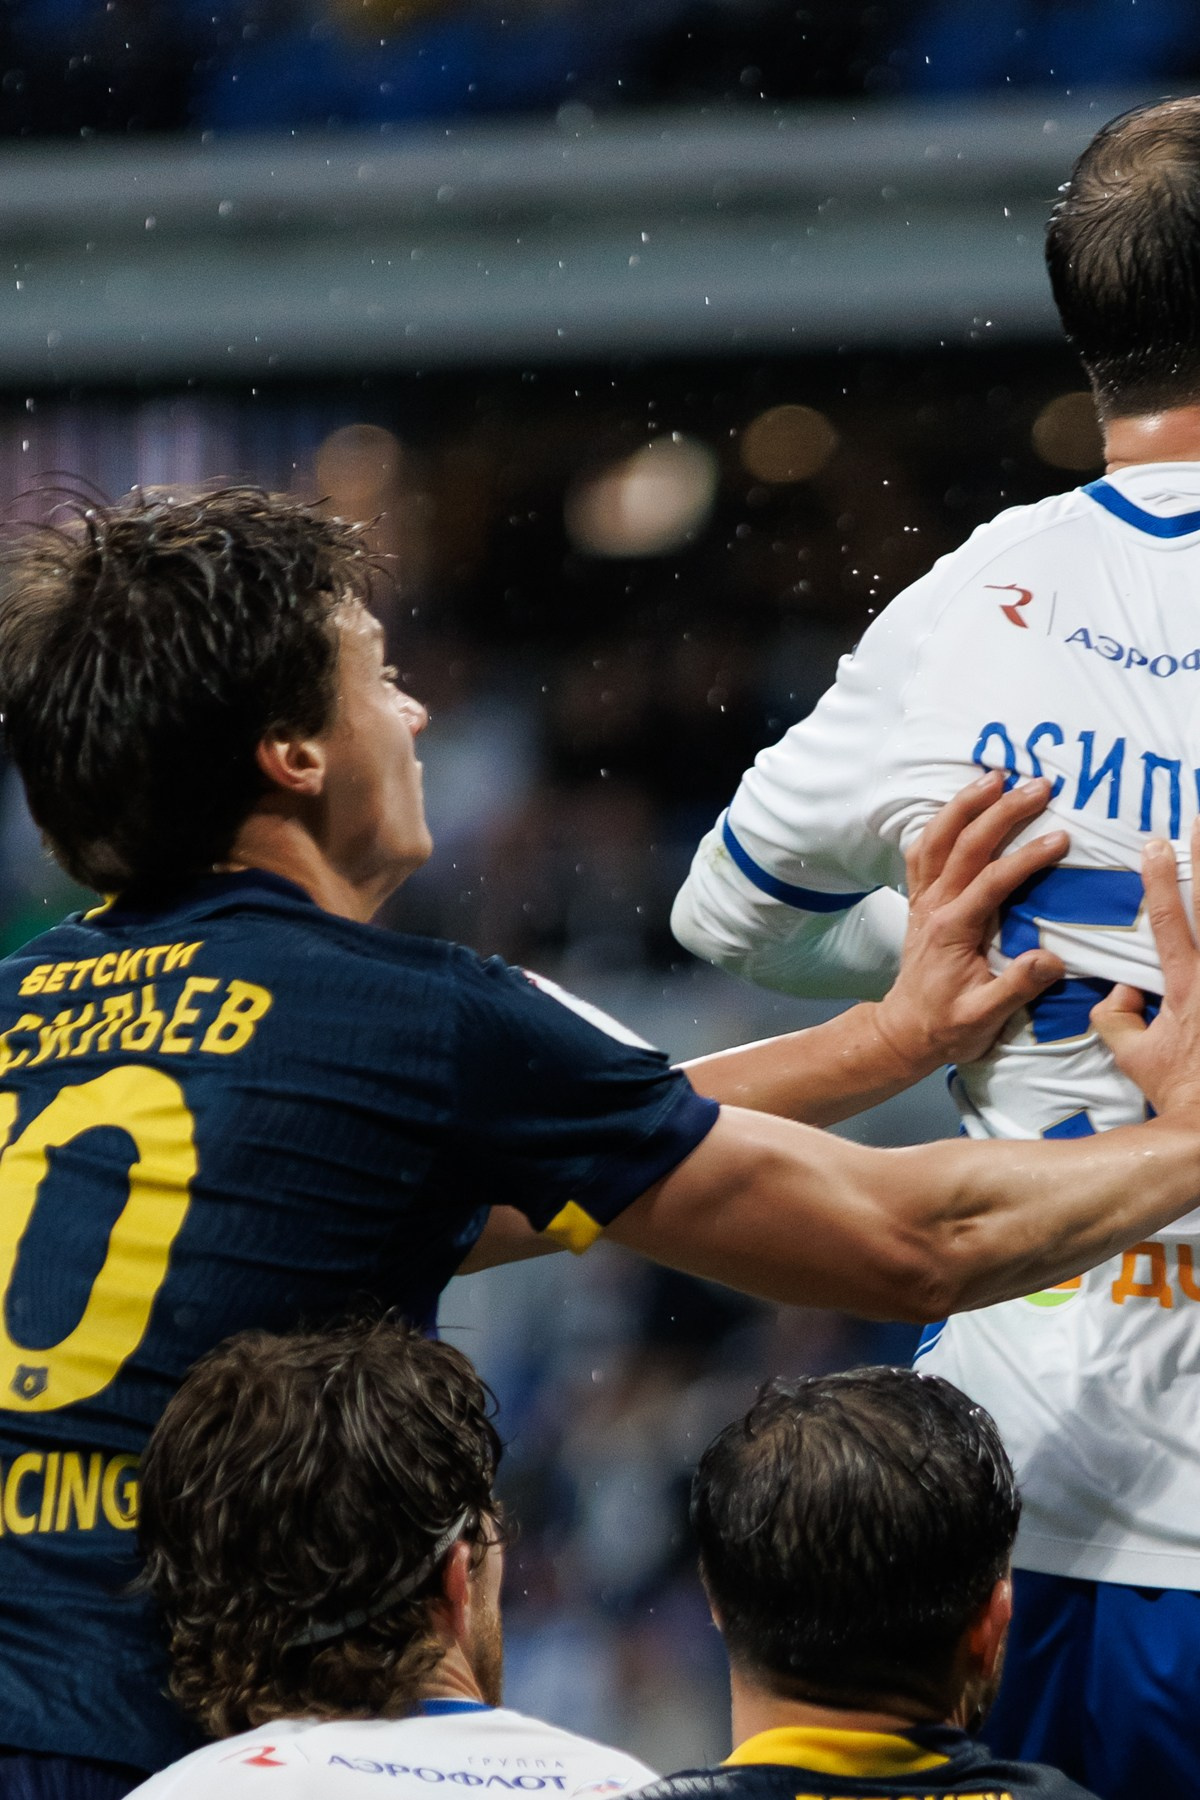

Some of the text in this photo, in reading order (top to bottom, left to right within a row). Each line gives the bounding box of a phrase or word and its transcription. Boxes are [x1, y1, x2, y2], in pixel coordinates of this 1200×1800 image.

[18, 940, 205, 996] БЕТСИТИ
[0, 1064, 198, 1413] 0
[0, 1452, 140, 1537] CING
[327, 1754, 566, 1791] АЭРОФЛОТ
[467, 1756, 565, 1768] ГРУППА
